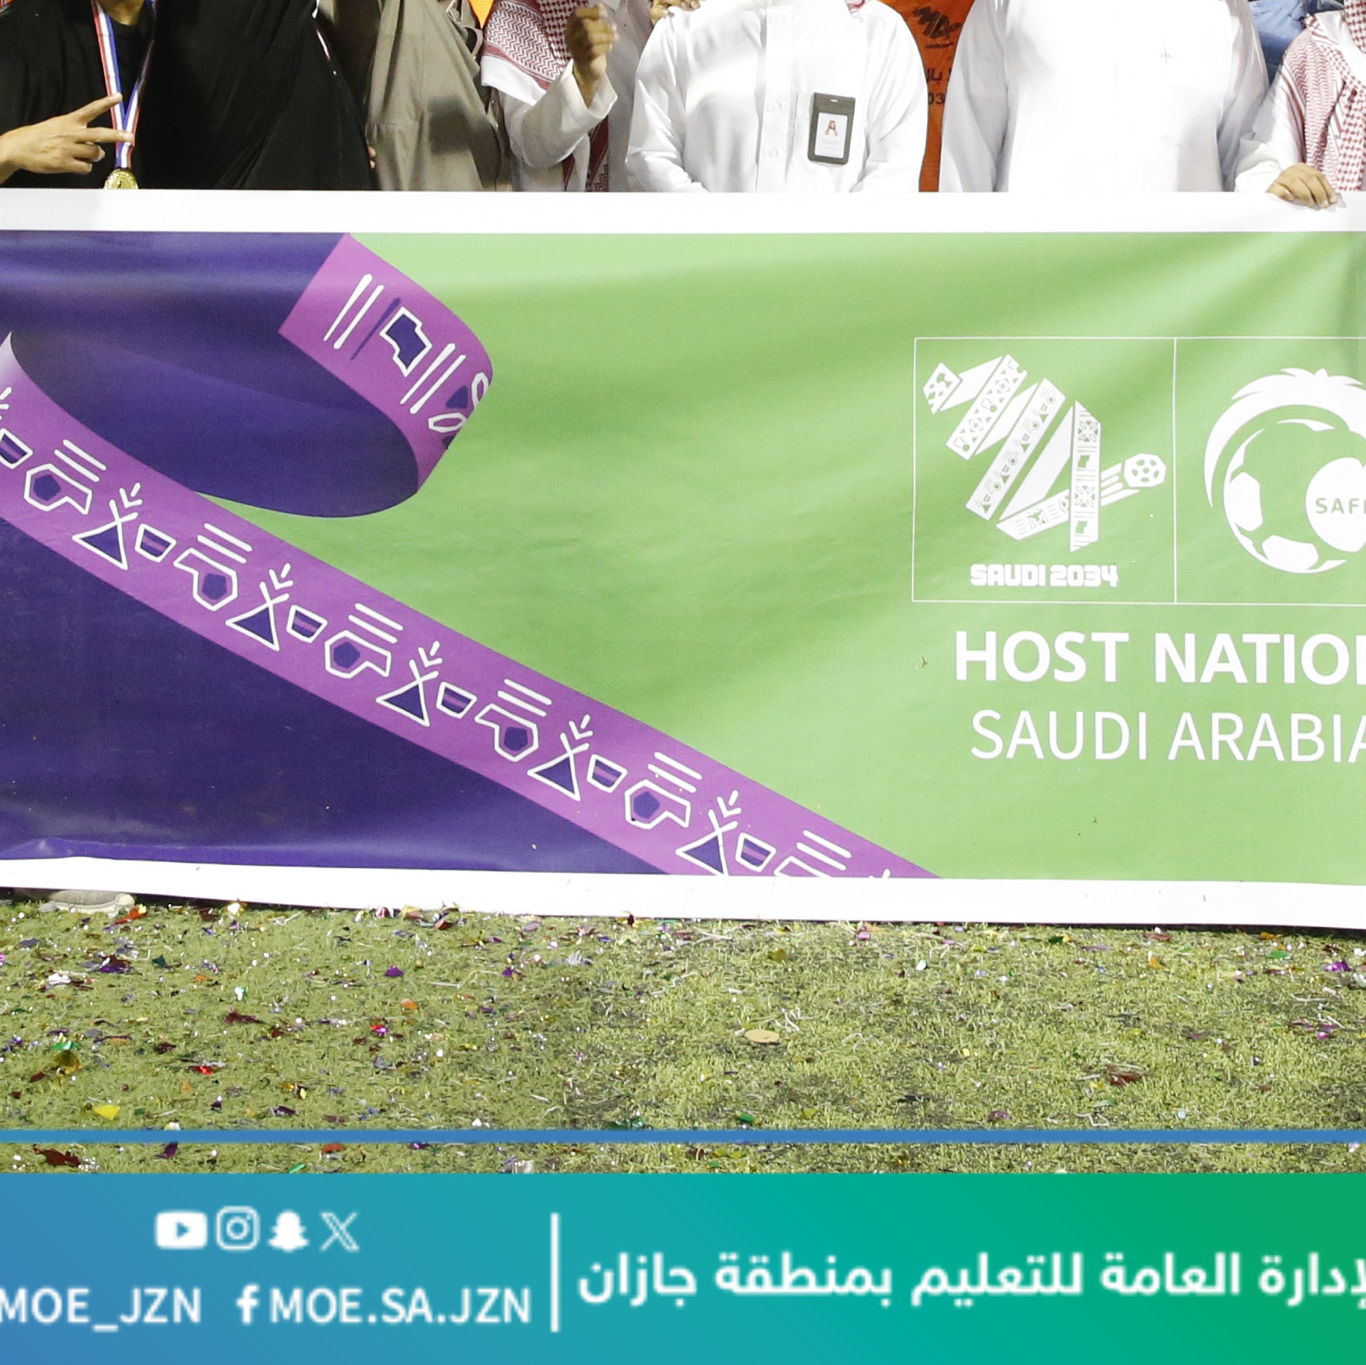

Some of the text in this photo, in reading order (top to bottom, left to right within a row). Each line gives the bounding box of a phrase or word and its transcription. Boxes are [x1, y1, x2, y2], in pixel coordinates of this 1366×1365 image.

[969, 563, 1120, 588] SAUDI 2034
[955, 630, 1130, 683] HOST
[970, 709, 1147, 761] SAUDI
